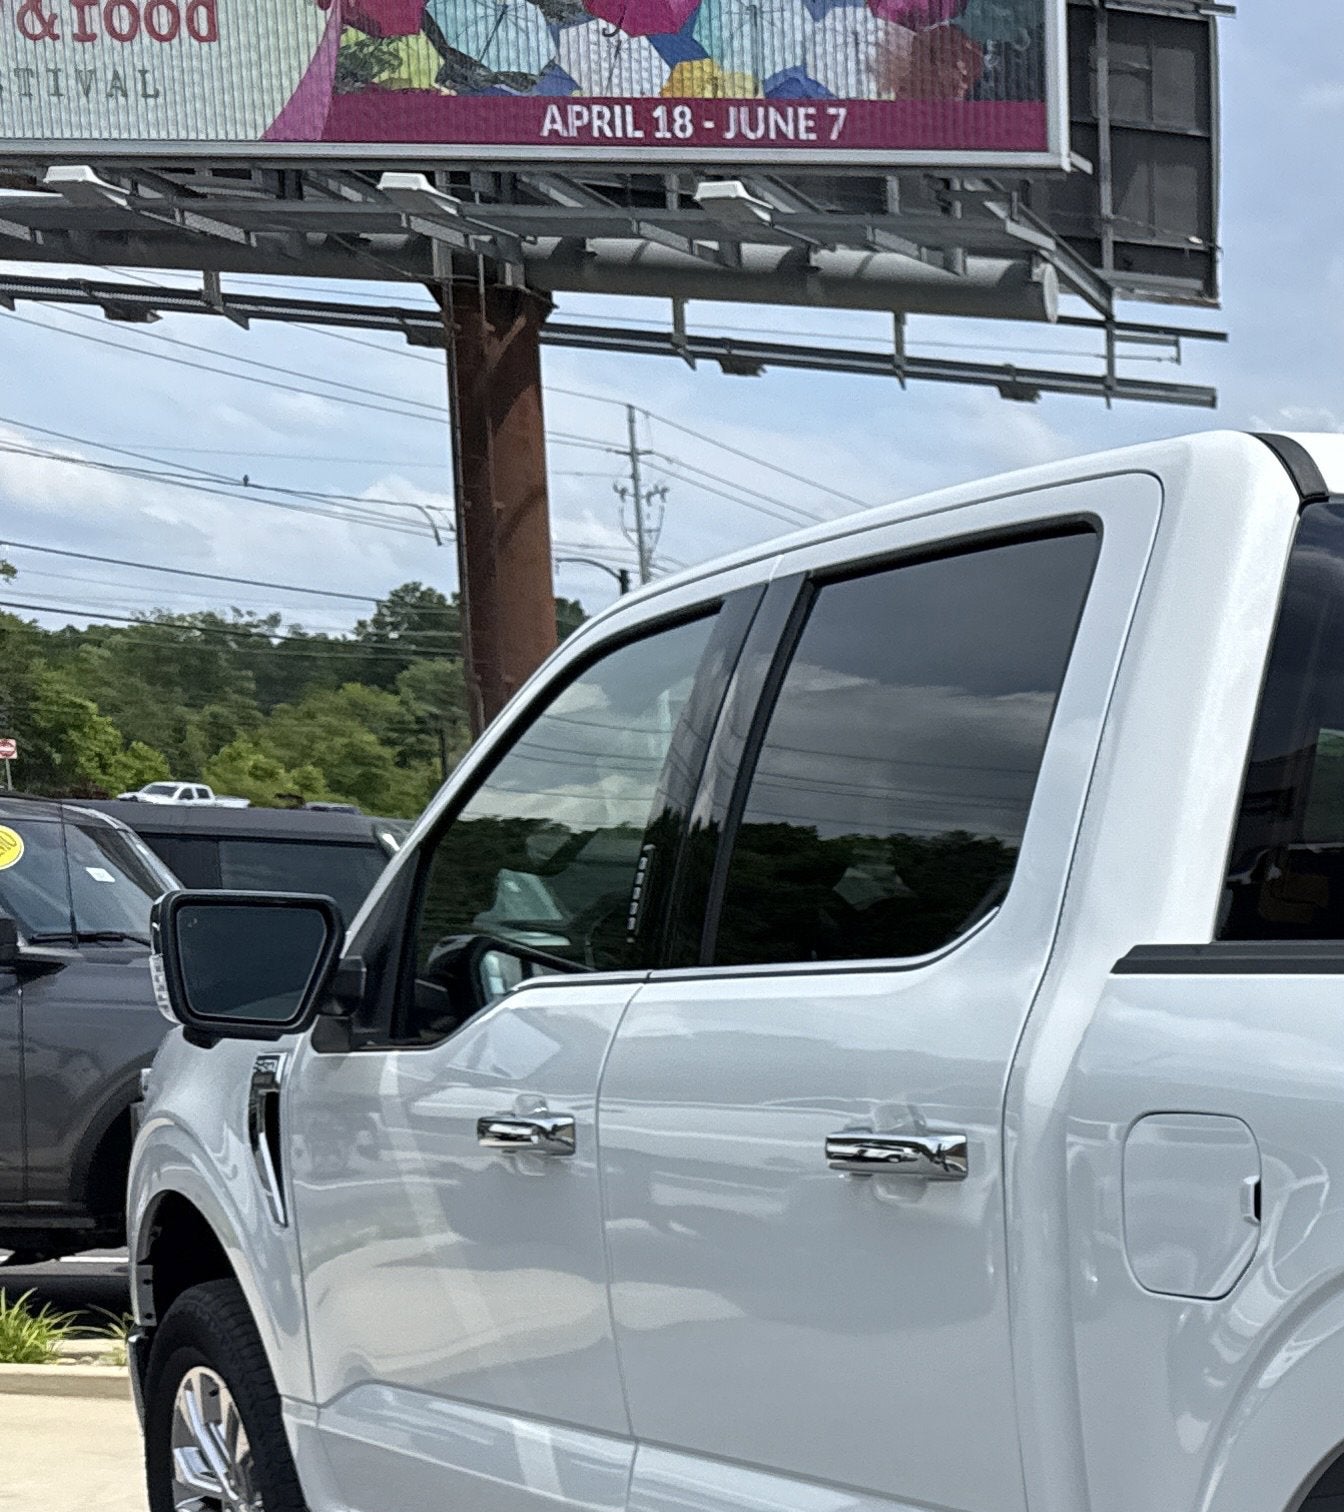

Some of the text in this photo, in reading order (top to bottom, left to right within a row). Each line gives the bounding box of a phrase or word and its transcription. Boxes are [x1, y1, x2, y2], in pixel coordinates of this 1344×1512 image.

[0, 67, 160, 99] TIVAL
[539, 104, 644, 139] APRIL
[652, 105, 694, 139] 18
[723, 106, 817, 140] JUNE
[826, 107, 847, 140] 7
